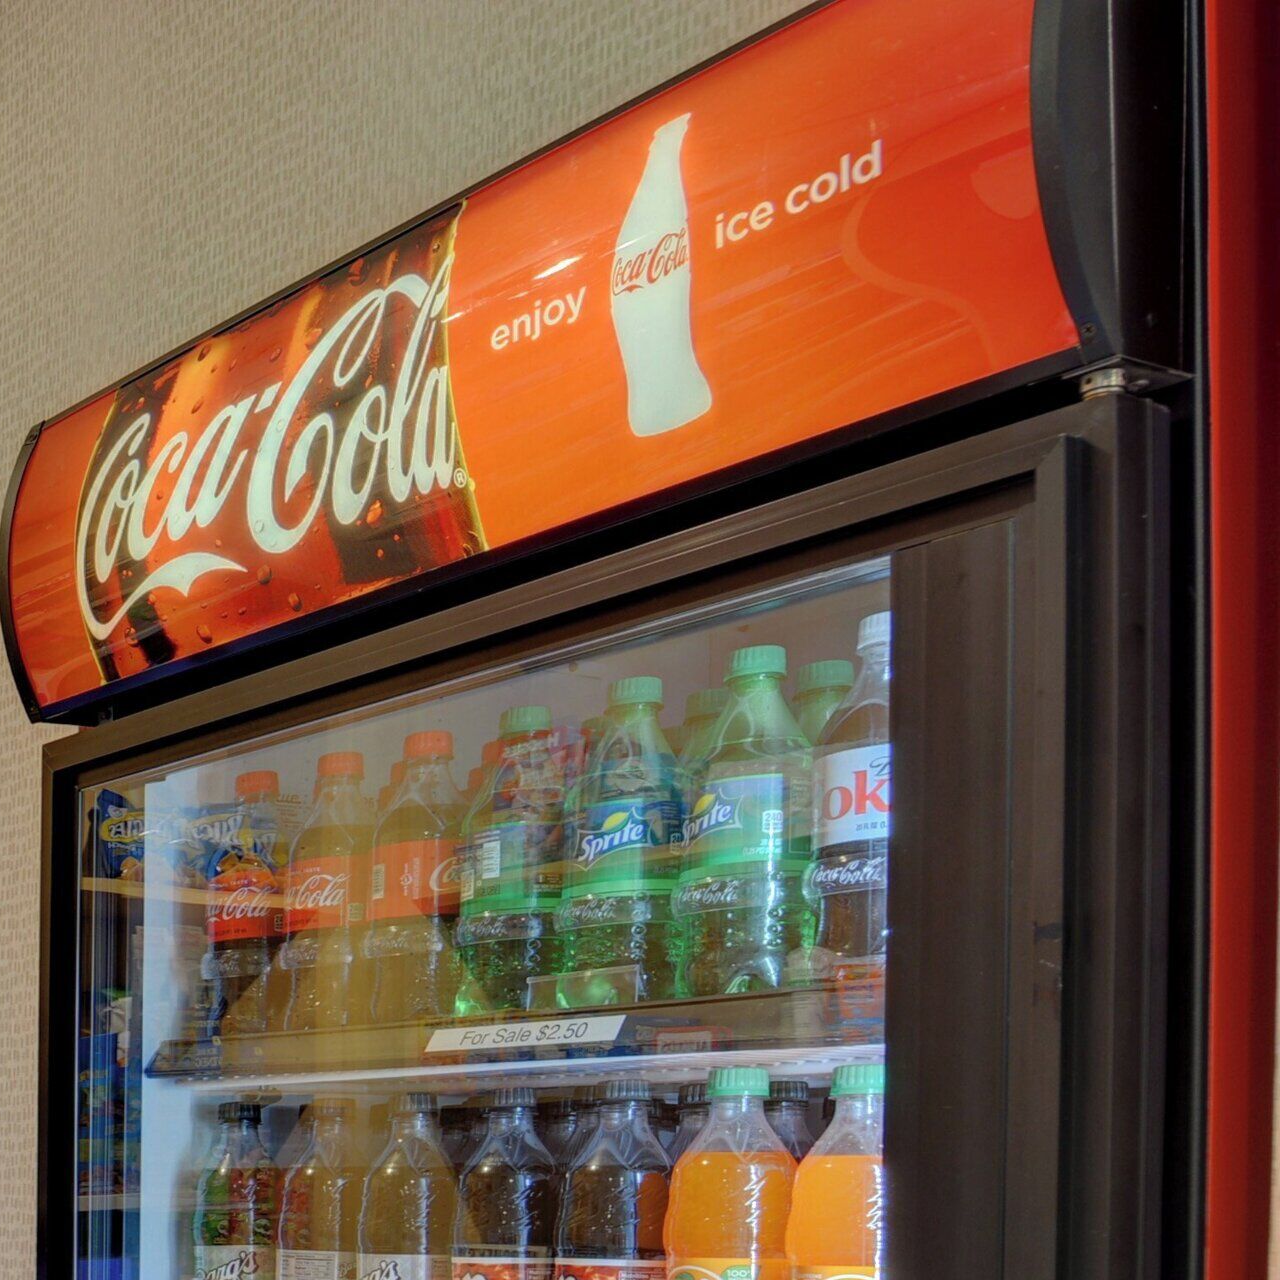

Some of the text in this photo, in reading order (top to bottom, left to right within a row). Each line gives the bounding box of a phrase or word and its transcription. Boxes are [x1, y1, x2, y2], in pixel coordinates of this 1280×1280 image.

[714, 139, 882, 248] ice cold
[611, 226, 689, 298] Coca-Cola
[490, 285, 587, 351] enjoy
[74, 255, 460, 642] Coca-Cola
[577, 821, 643, 863] Sprite
[682, 803, 732, 847] Sprite
[460, 1022, 588, 1047] For Sale $2.50
